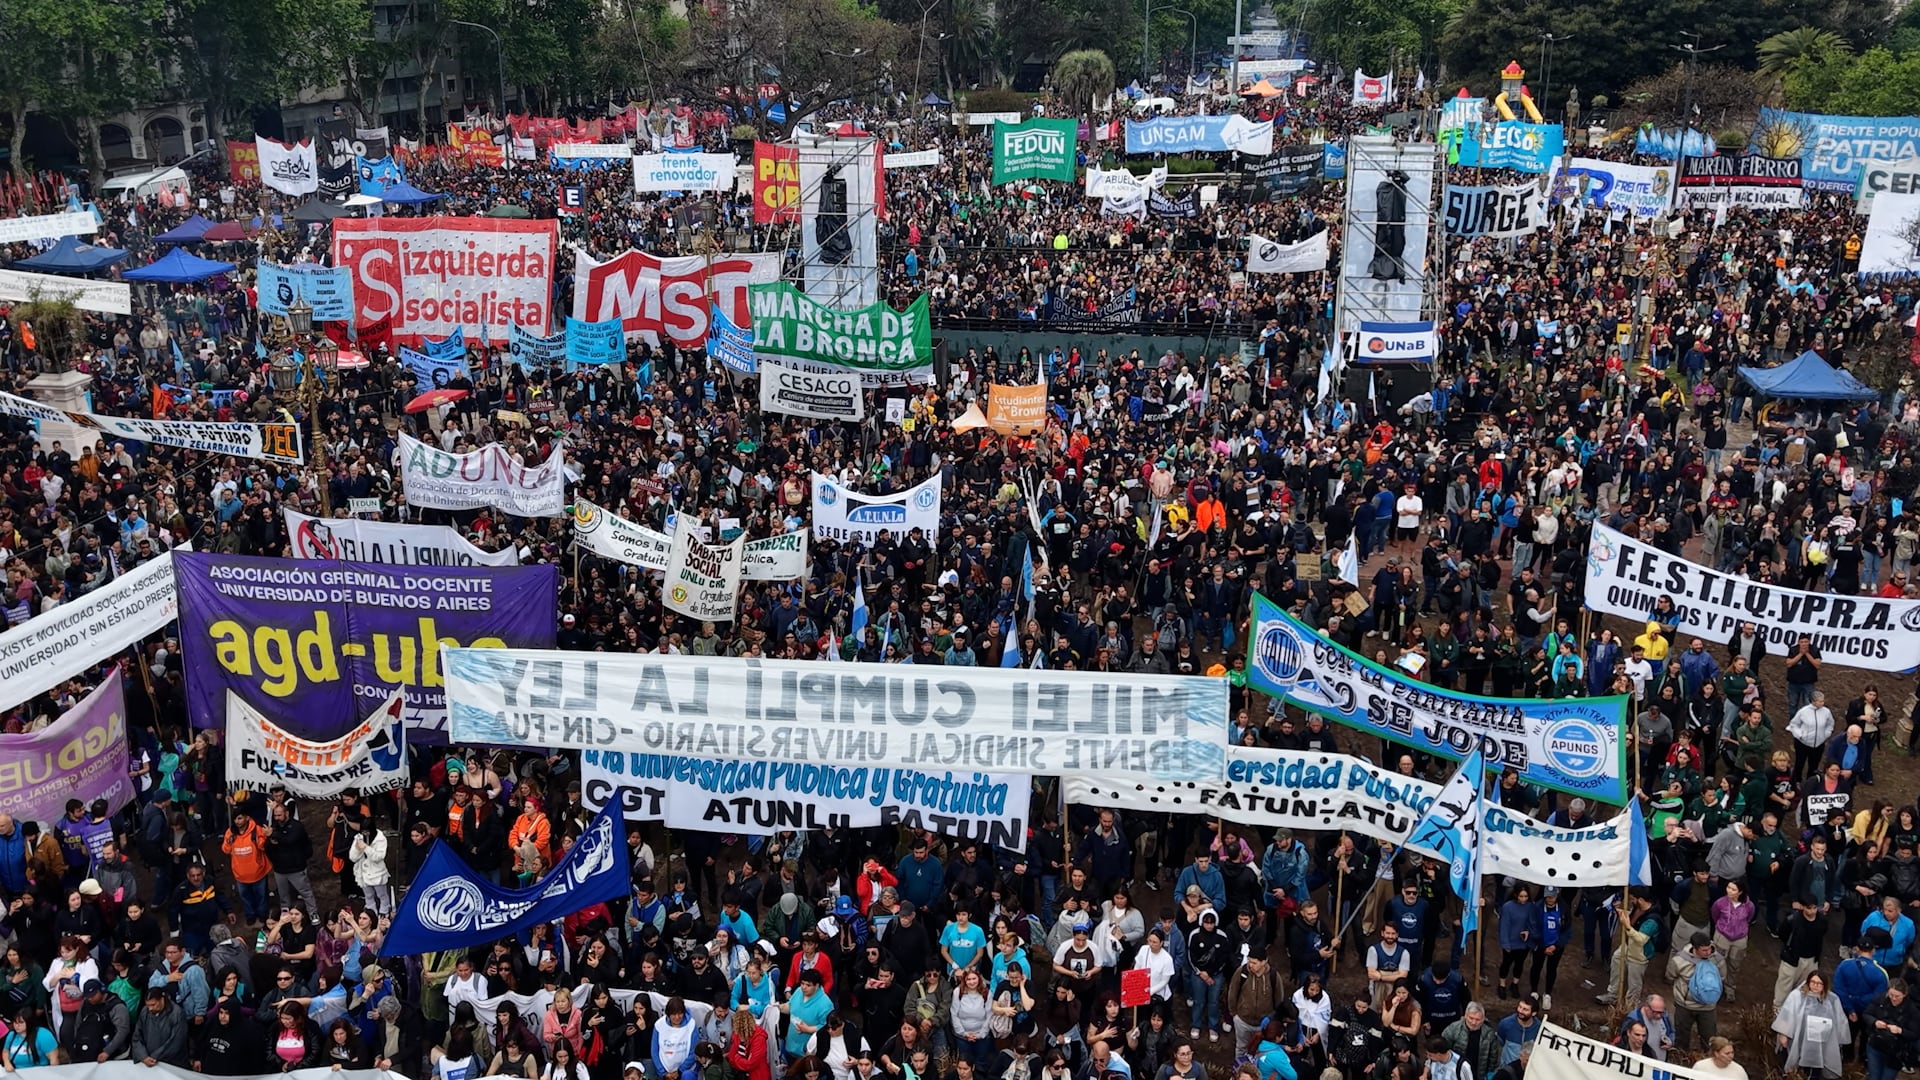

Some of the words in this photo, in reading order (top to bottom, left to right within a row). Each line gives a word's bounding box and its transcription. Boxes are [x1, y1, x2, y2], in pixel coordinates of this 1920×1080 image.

[1140, 125, 1206, 146] UNSAM
[1820, 123, 1875, 137] FRENTE
[1004, 131, 1065, 157] FEDUN
[1815, 137, 1919, 158] PATRIA
[650, 167, 717, 182] renovador
[660, 155, 699, 169] frente
[1740, 155, 1800, 178] FIERRO
[1735, 191, 1790, 204] NACIONAL
[1818, 181, 1857, 192] DEREC
[1444, 187, 1535, 235] SURGE
[402, 240, 544, 283] izquierda
[405, 290, 542, 326] socialista
[600, 266, 752, 342] MST
[754, 291, 874, 337] MARCHA
[881, 311, 916, 339] DE
[753, 320, 786, 349] LA
[796, 323, 917, 364] BRONCA
[1385, 339, 1426, 351] UNaB
[779, 373, 851, 395] CESACO
[805, 394, 814, 402] de
[201, 430, 253, 446] FUTURO
[456, 485, 468, 496] de
[611, 530, 650, 549] Somos
[654, 541, 664, 552] la
[818, 525, 848, 540] SEDE
[687, 532, 733, 563] TRABAJO
[209, 565, 318, 585] ASOCIACIÓN
[320, 571, 400, 590] GREMIAL
[403, 576, 493, 593] DOCENTE
[685, 553, 722, 579] SOCIAL
[215, 581, 331, 603] UNIVERSIDAD
[331, 588, 353, 605] DE
[355, 590, 432, 610] BUENOS
[435, 595, 492, 612] AIRES
[689, 602, 699, 613] de
[36, 605, 95, 643] MOVILIDAD
[96, 585, 132, 611] SOCIAL
[1706, 611, 1718, 630] Y
[0, 633, 79, 681] UNIVERSIDAD
[78, 627, 88, 641] Y
[90, 617, 108, 637] SIN
[108, 599, 146, 628] ESTADO
[1313, 639, 1353, 676] CON
[1360, 666, 1384, 690] LA
[1392, 683, 1528, 737] PARITARIA
[1367, 694, 1414, 738] SE
[1423, 718, 1530, 773] JODE
[1532, 724, 1543, 736] NI
[1576, 706, 1587, 714] NI
[1587, 709, 1618, 745] TRAIDOR
[1551, 740, 1599, 755] APUNGS
[1227, 757, 1344, 790] ersidad
[586, 779, 665, 815] CGT
[1200, 788, 1409, 835] FATUN-ATU
[1537, 1026, 1644, 1078] ARTURO
